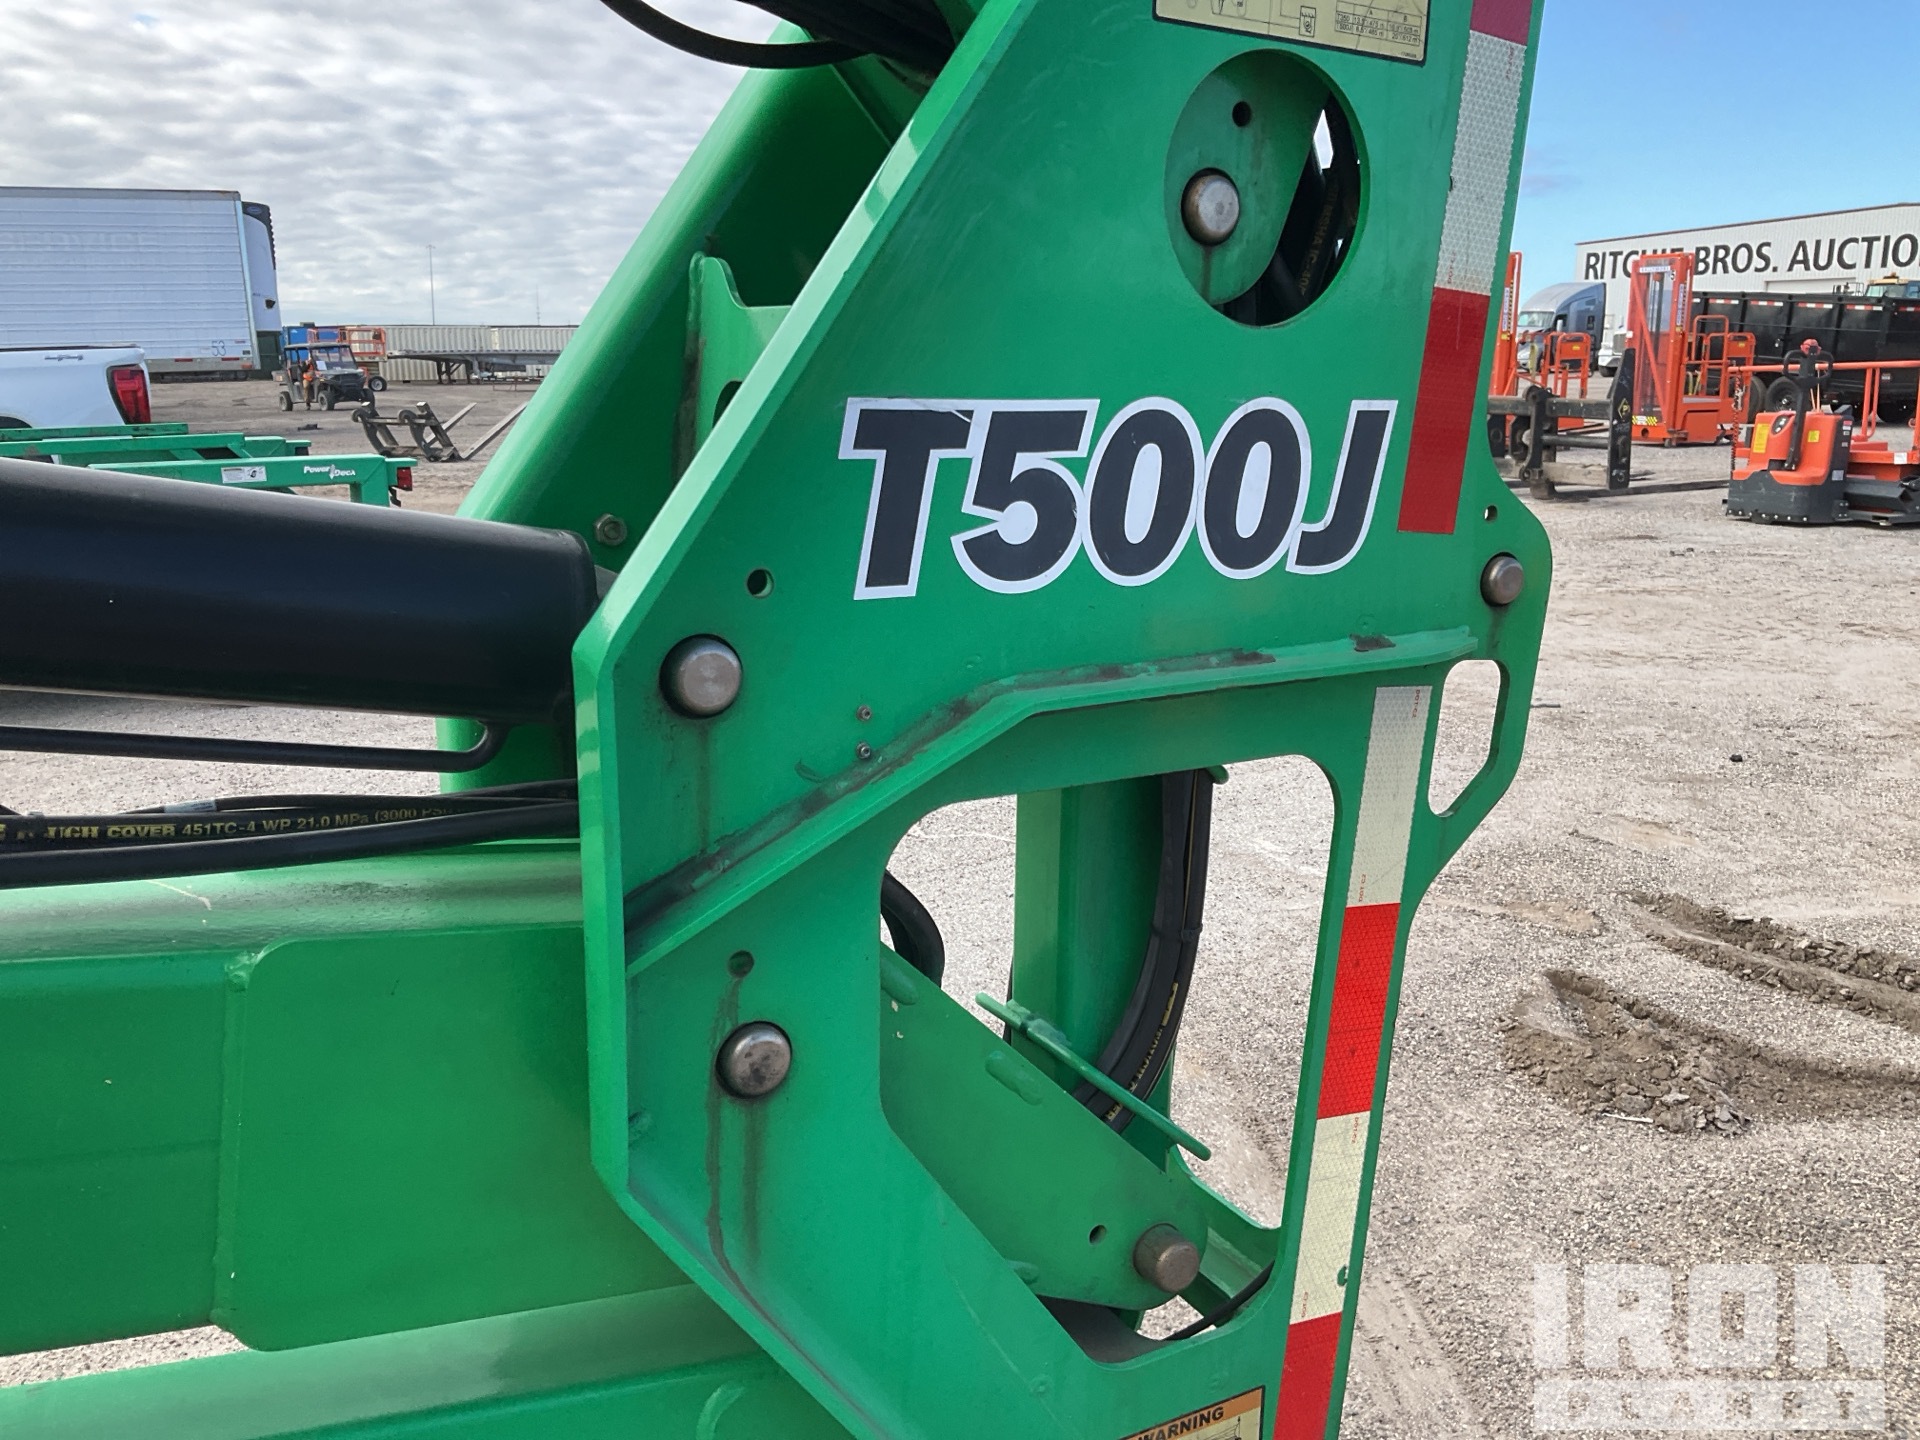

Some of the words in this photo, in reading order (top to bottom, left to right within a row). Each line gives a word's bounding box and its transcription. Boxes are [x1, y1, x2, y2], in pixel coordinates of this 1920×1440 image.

[1584, 248, 1684, 281] RITC
[1695, 242, 1779, 275] BROS.
[1787, 234, 1920, 272] AUCTIO
[211, 340, 227, 357] 53
[303, 465, 331, 474] Power
[838, 395, 1398, 600] T500J
[106, 824, 175, 838] COVER
[182, 820, 257, 837] 451TC-4
[262, 818, 292, 833] WP
[297, 816, 330, 830] 21.0
[334, 812, 369, 827] MPa
